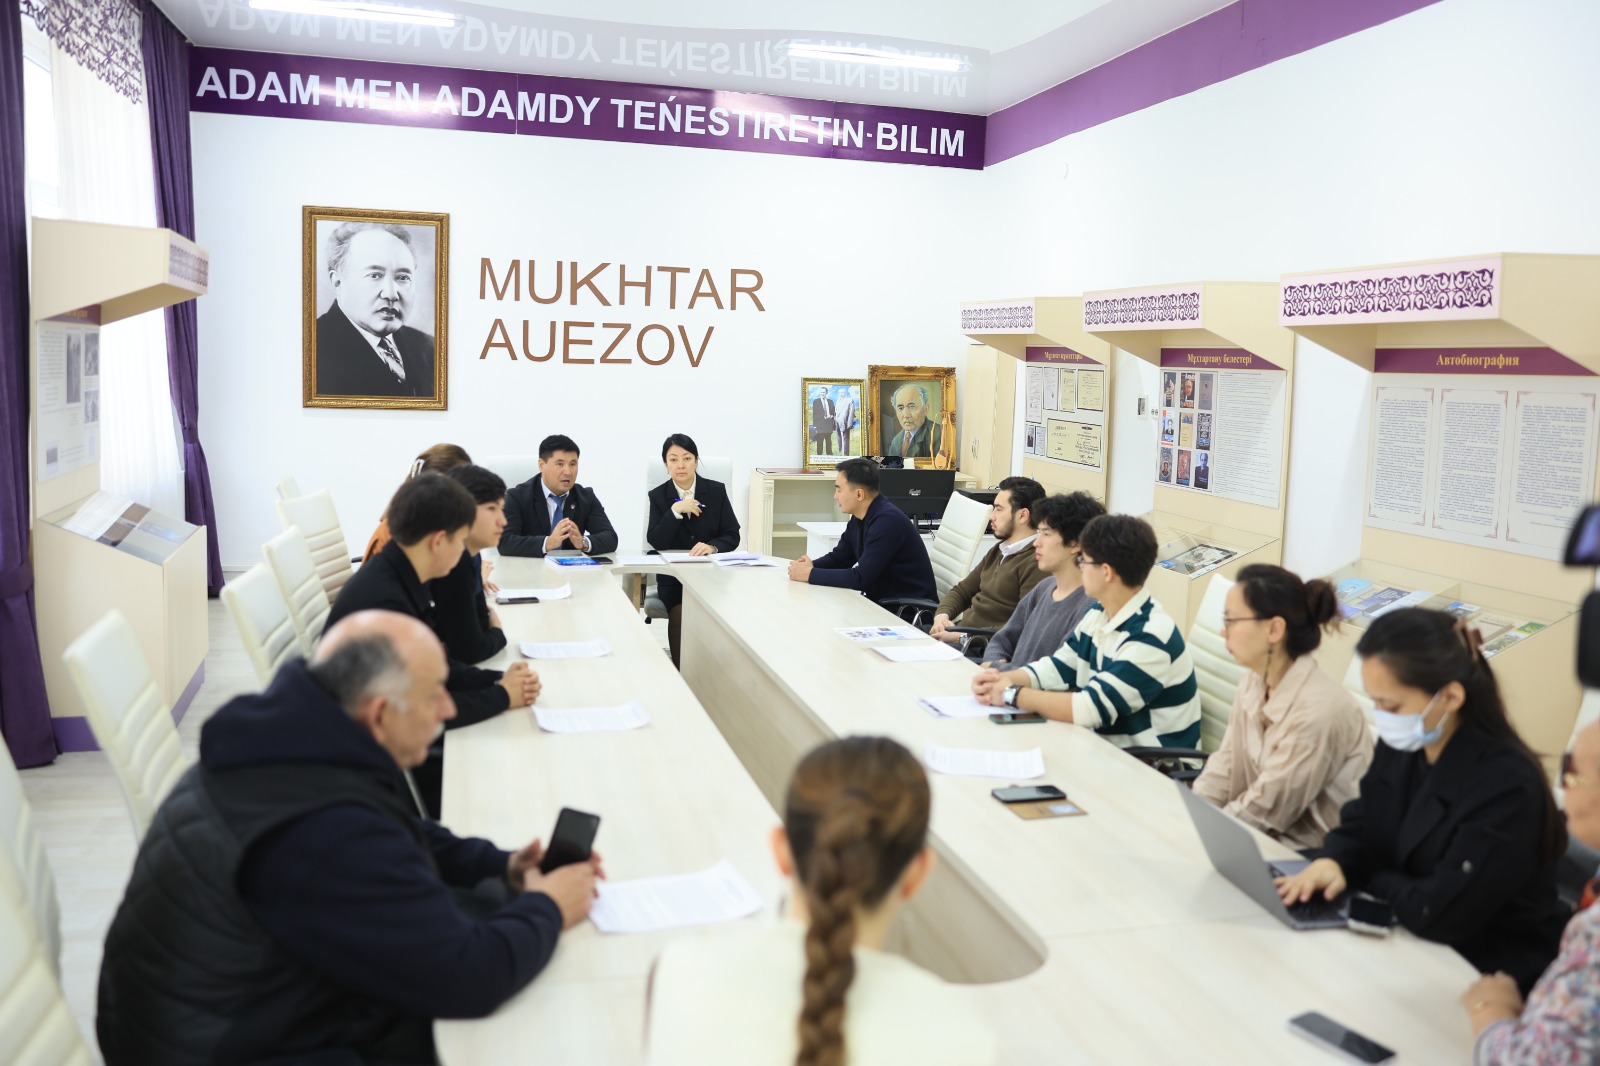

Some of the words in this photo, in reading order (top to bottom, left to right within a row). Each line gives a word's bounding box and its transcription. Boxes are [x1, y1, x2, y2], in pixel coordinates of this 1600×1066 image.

[196, 66, 320, 106] ADAM
[335, 76, 420, 112] MEN
[431, 85, 601, 126] ADAMDY
[479, 257, 766, 312] MUKHTAR
[479, 318, 715, 368] AUEZOV
[1436, 353, 1519, 369] Автобиография
